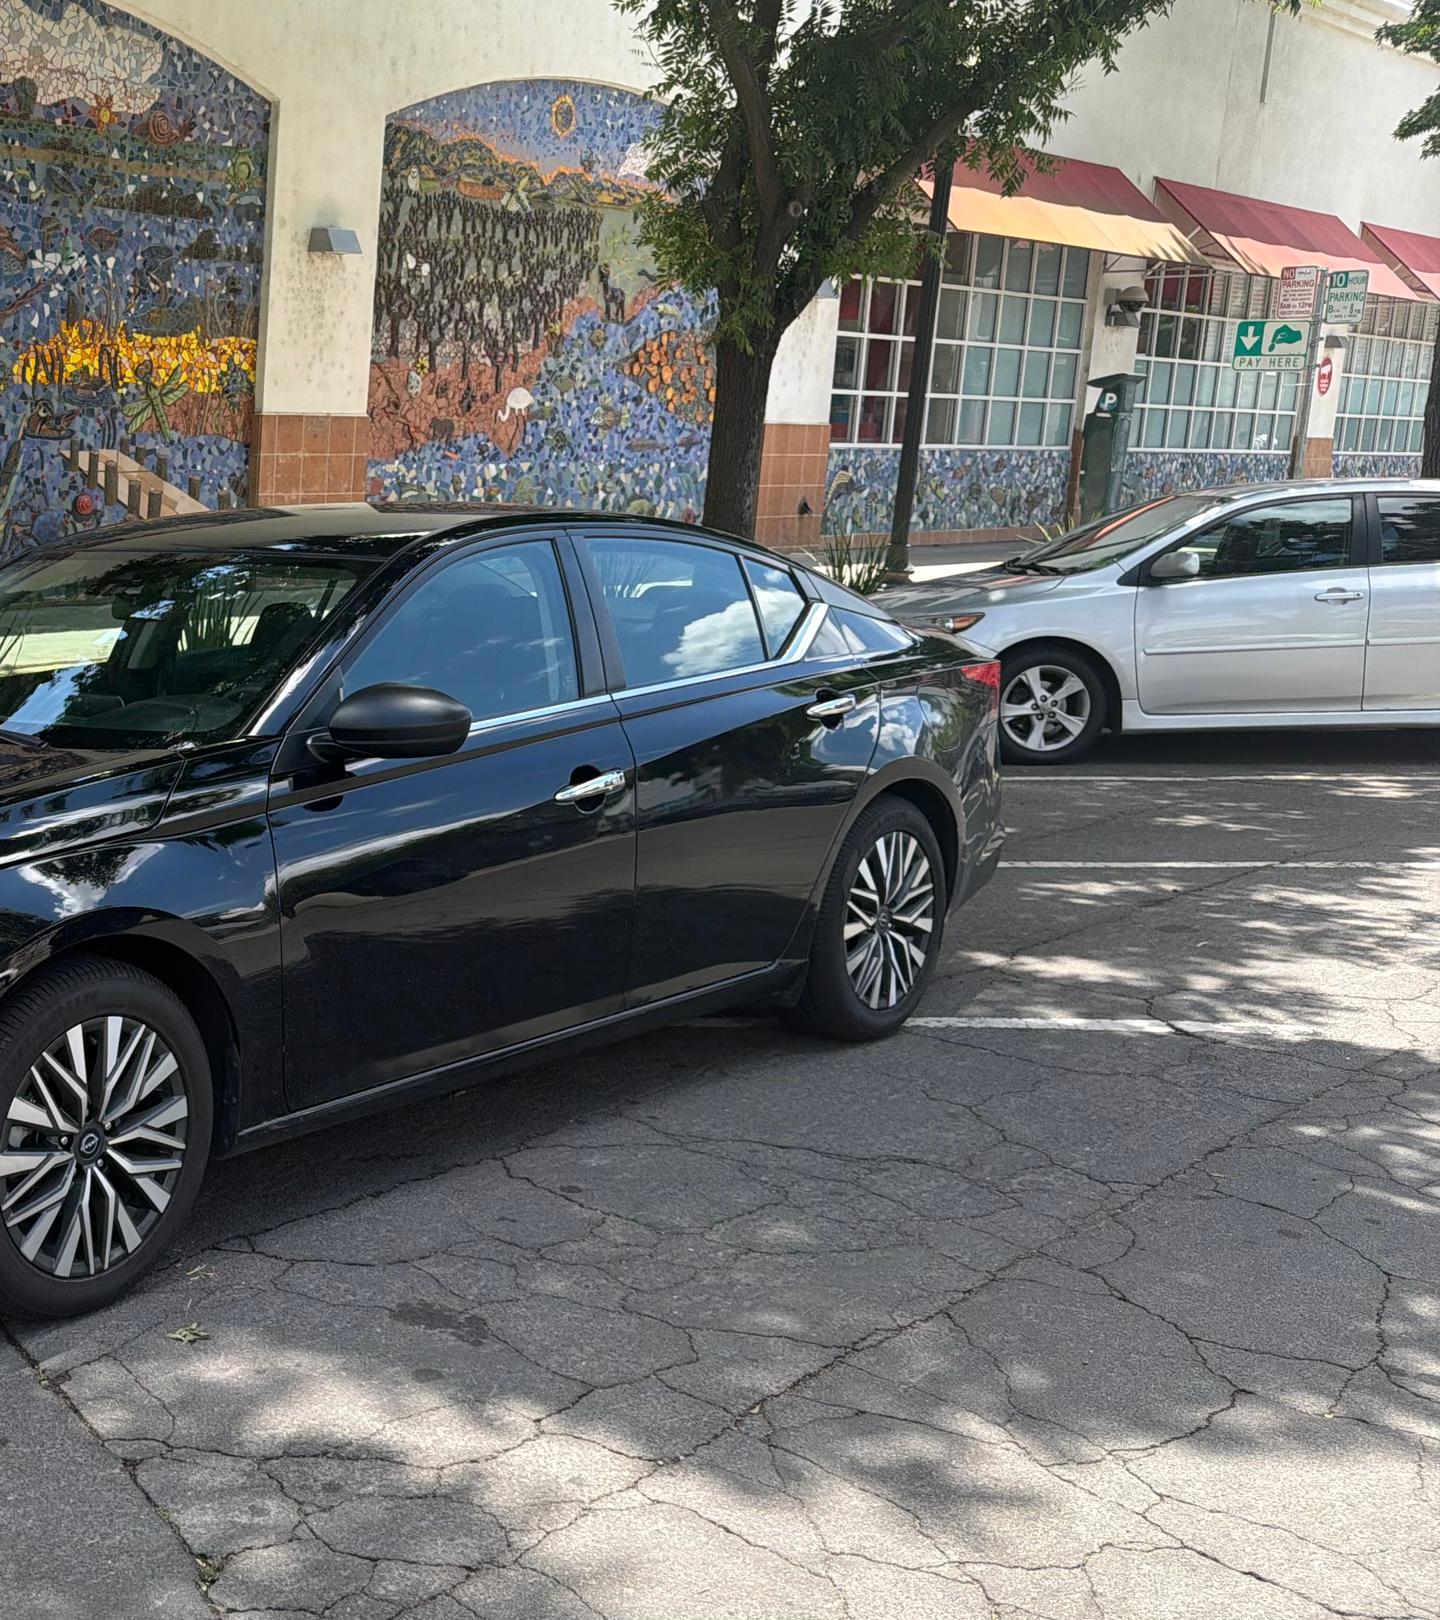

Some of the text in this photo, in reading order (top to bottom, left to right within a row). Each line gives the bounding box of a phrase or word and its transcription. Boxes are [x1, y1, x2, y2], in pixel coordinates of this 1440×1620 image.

[1283, 269, 1294, 279] NO
[1283, 279, 1314, 288] PARKING
[1332, 273, 1367, 287] 10 HOUR
[1329, 292, 1365, 302] PARKING
[1239, 357, 1299, 368] PAY HERE
[1103, 392, 1117, 411] P
